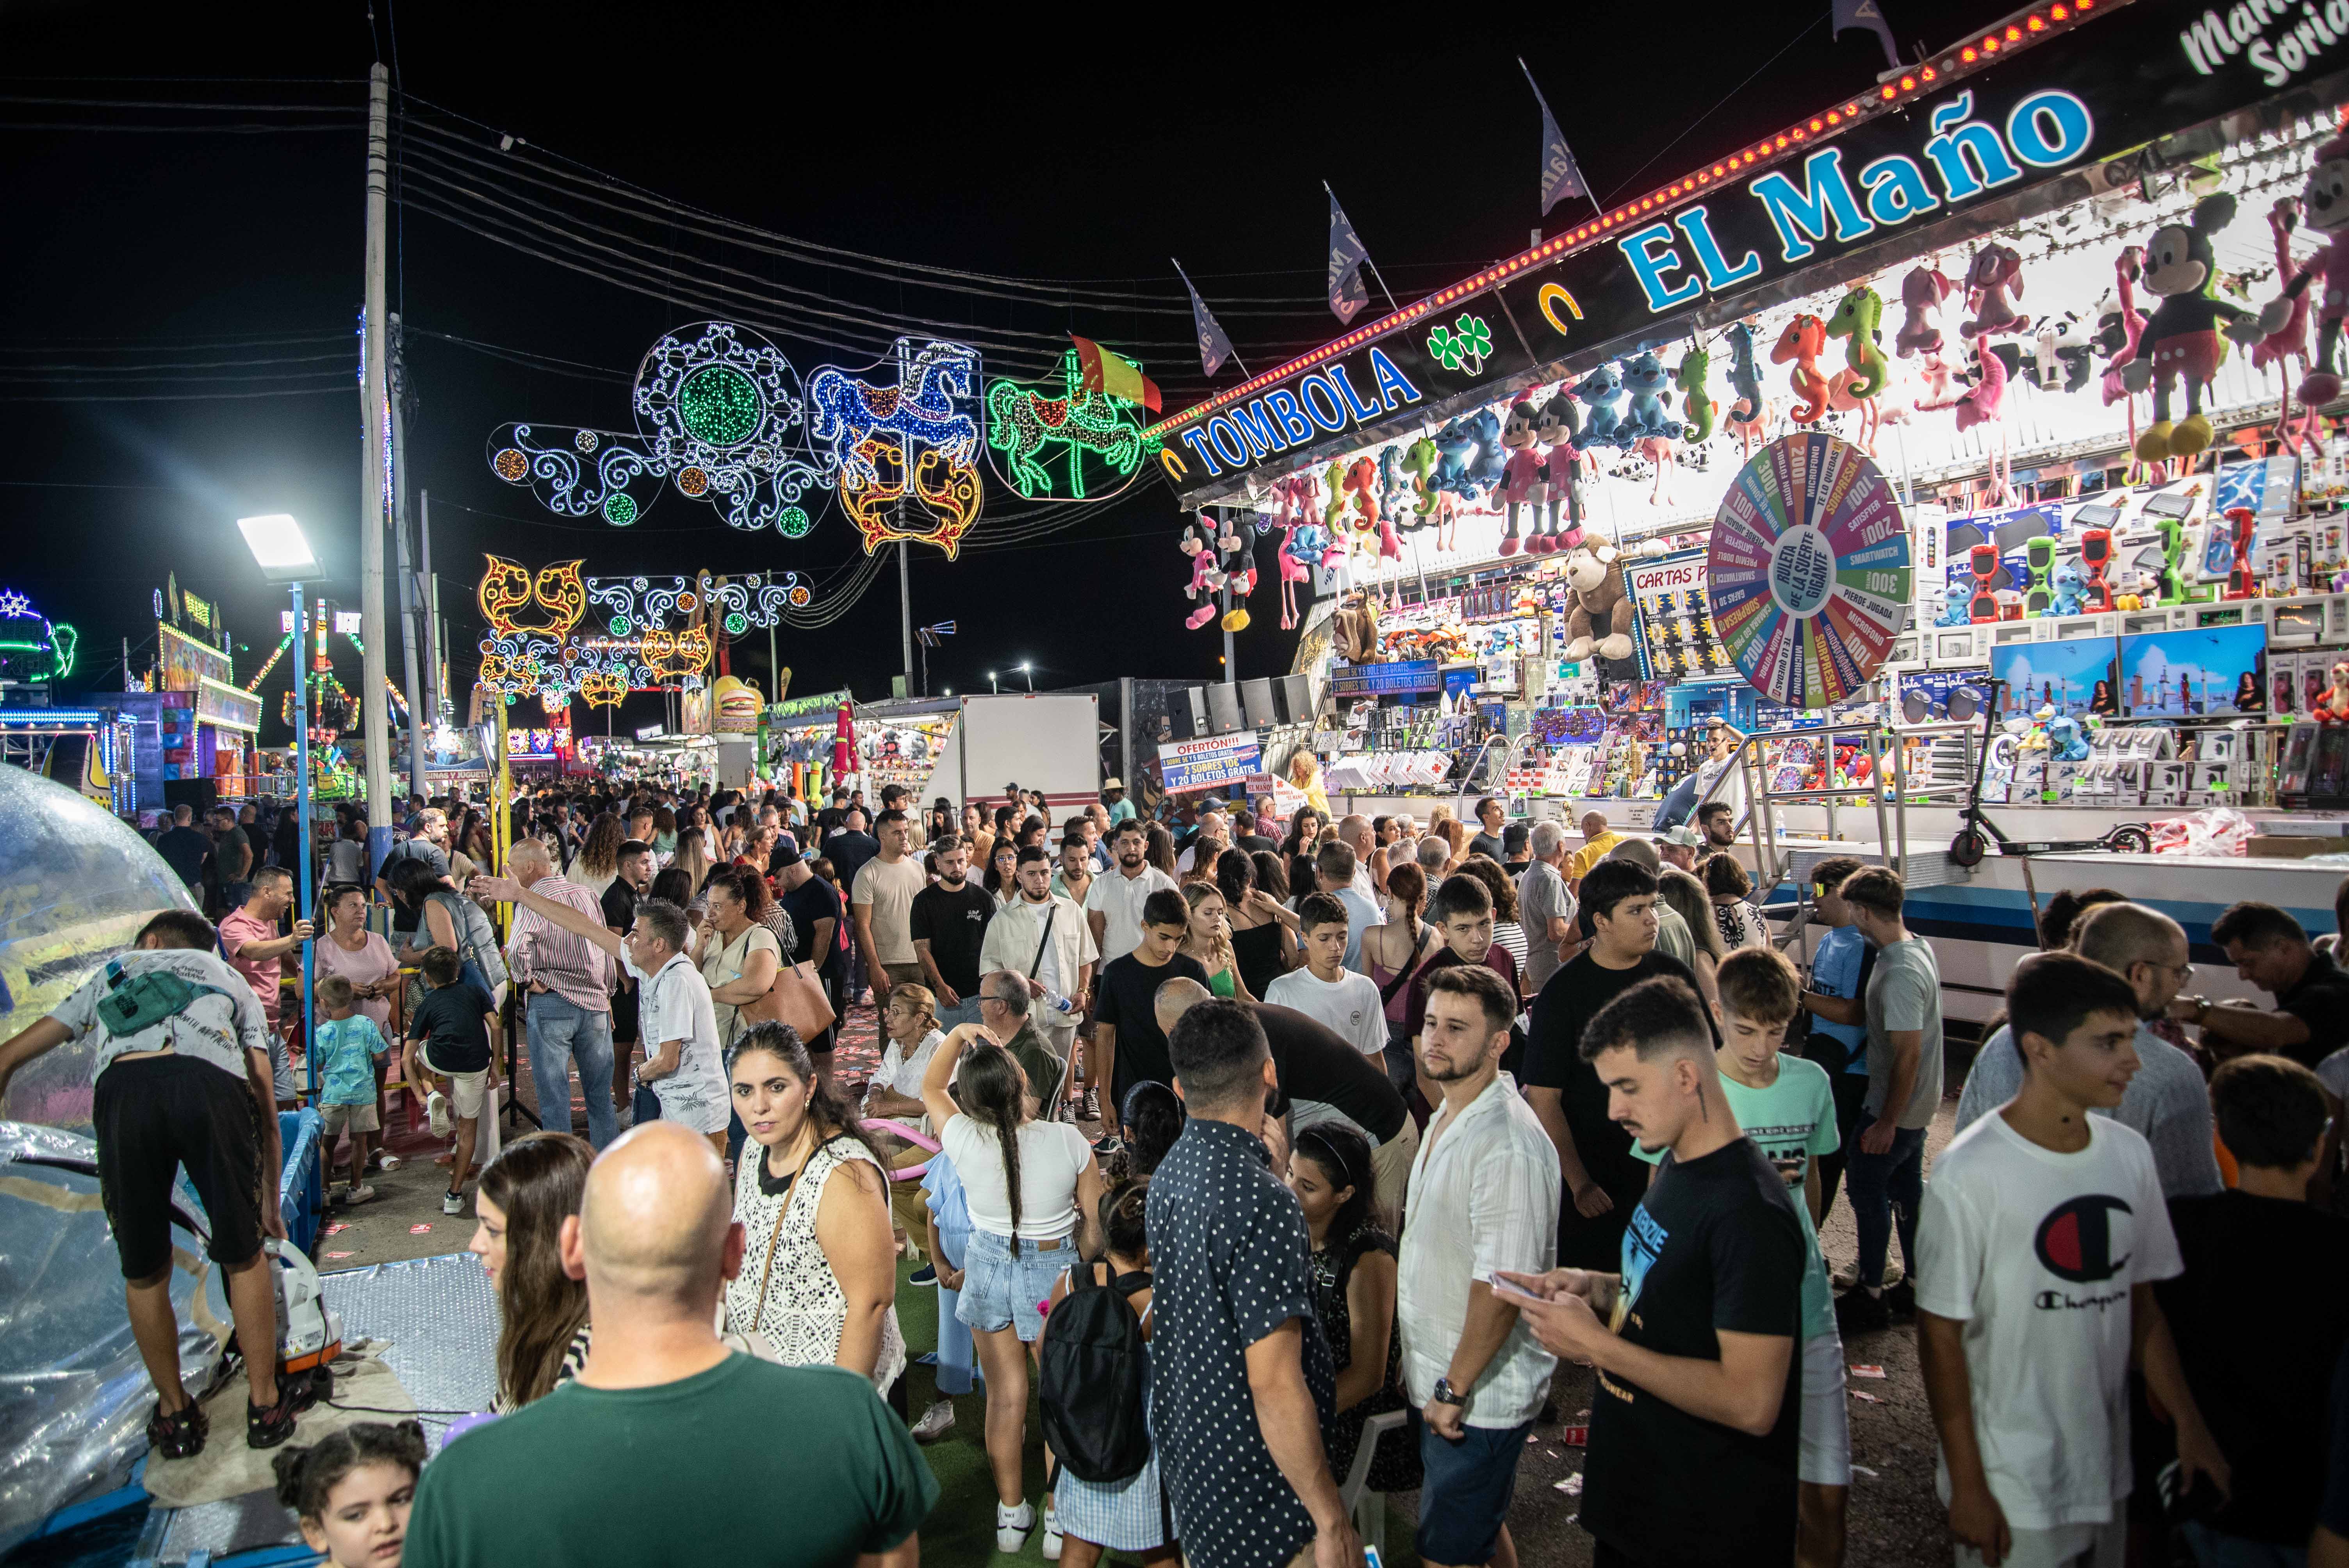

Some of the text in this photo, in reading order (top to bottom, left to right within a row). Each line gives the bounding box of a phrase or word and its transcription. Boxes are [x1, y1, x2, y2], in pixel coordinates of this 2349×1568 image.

[1618, 89, 2094, 313] EL Maño
[1181, 347, 1422, 477] TOMBOLA
[1758, 460, 1778, 492] 300
[1792, 446, 1805, 478] 200
[1807, 446, 1820, 497] MICROFONO
[1746, 476, 1763, 502] SONIDO
[1777, 452, 1793, 506] BALÓN FÚTBOL
[1818, 450, 1839, 506] TE LO QUEDAS
[1826, 461, 1857, 515] SORPRESA
[1850, 475, 1875, 506] 100
[1733, 492, 1754, 519] 100
[1764, 508, 1779, 532] TORRE
[1848, 499, 1881, 531] SATISFYER
[1725, 515, 1764, 547] PIERDE JUGADA
[1725, 535, 1754, 554] SATISFYER
[1867, 516, 1894, 544] 200
[1717, 551, 1757, 567] PREMIO DOBLE
[1777, 545, 1797, 584] RULETA
[1791, 531, 1813, 608] DE LA SUERTE
[1850, 546, 1898, 565] SMARTWATCH
[1637, 568, 1691, 589] CARTAS
[1716, 570, 1755, 583] SMARTWATCH
[1806, 550, 1827, 599] GIGANTE
[1871, 572, 1898, 594] 300
[1719, 589, 1745, 606] GAFAS 3D
[1724, 597, 1760, 629] SORPRESA
[1844, 589, 1893, 620] PIERDE JUGADA
[1734, 604, 1772, 650] CÁMARA GO PRO
[1784, 638, 1791, 647] TE
[1847, 611, 1885, 647] MICROFONO
[1743, 638, 1763, 670] 200
[1759, 629, 1783, 679] BALÓN FÚTBOL
[1815, 633, 1837, 690] SORPRESA
[1848, 637, 1871, 668] 100
[1335, 674, 1437, 692] 2 SOBRES 10€ Y 20 BOLETOS GRATIS
[1336, 670, 1350, 678] SOBRE
[1351, 668, 1358, 676] 5€
[1367, 665, 1389, 675] BOLETOS
[1390, 663, 1409, 673] GRATIS
[1776, 659, 1787, 690] QUEDAS
[1793, 645, 1803, 695] MICROFONO
[1805, 664, 1822, 695] 300
[1900, 677, 1921, 691] Jata
[1178, 737, 1239, 755] OFERTÓN!!!
[1197, 752, 1217, 761] BOLETOS
[1171, 764, 1256, 787] Y 20 BOLETOS GRATIS
[1184, 757, 1240, 775] 2 SOBRES 10€
